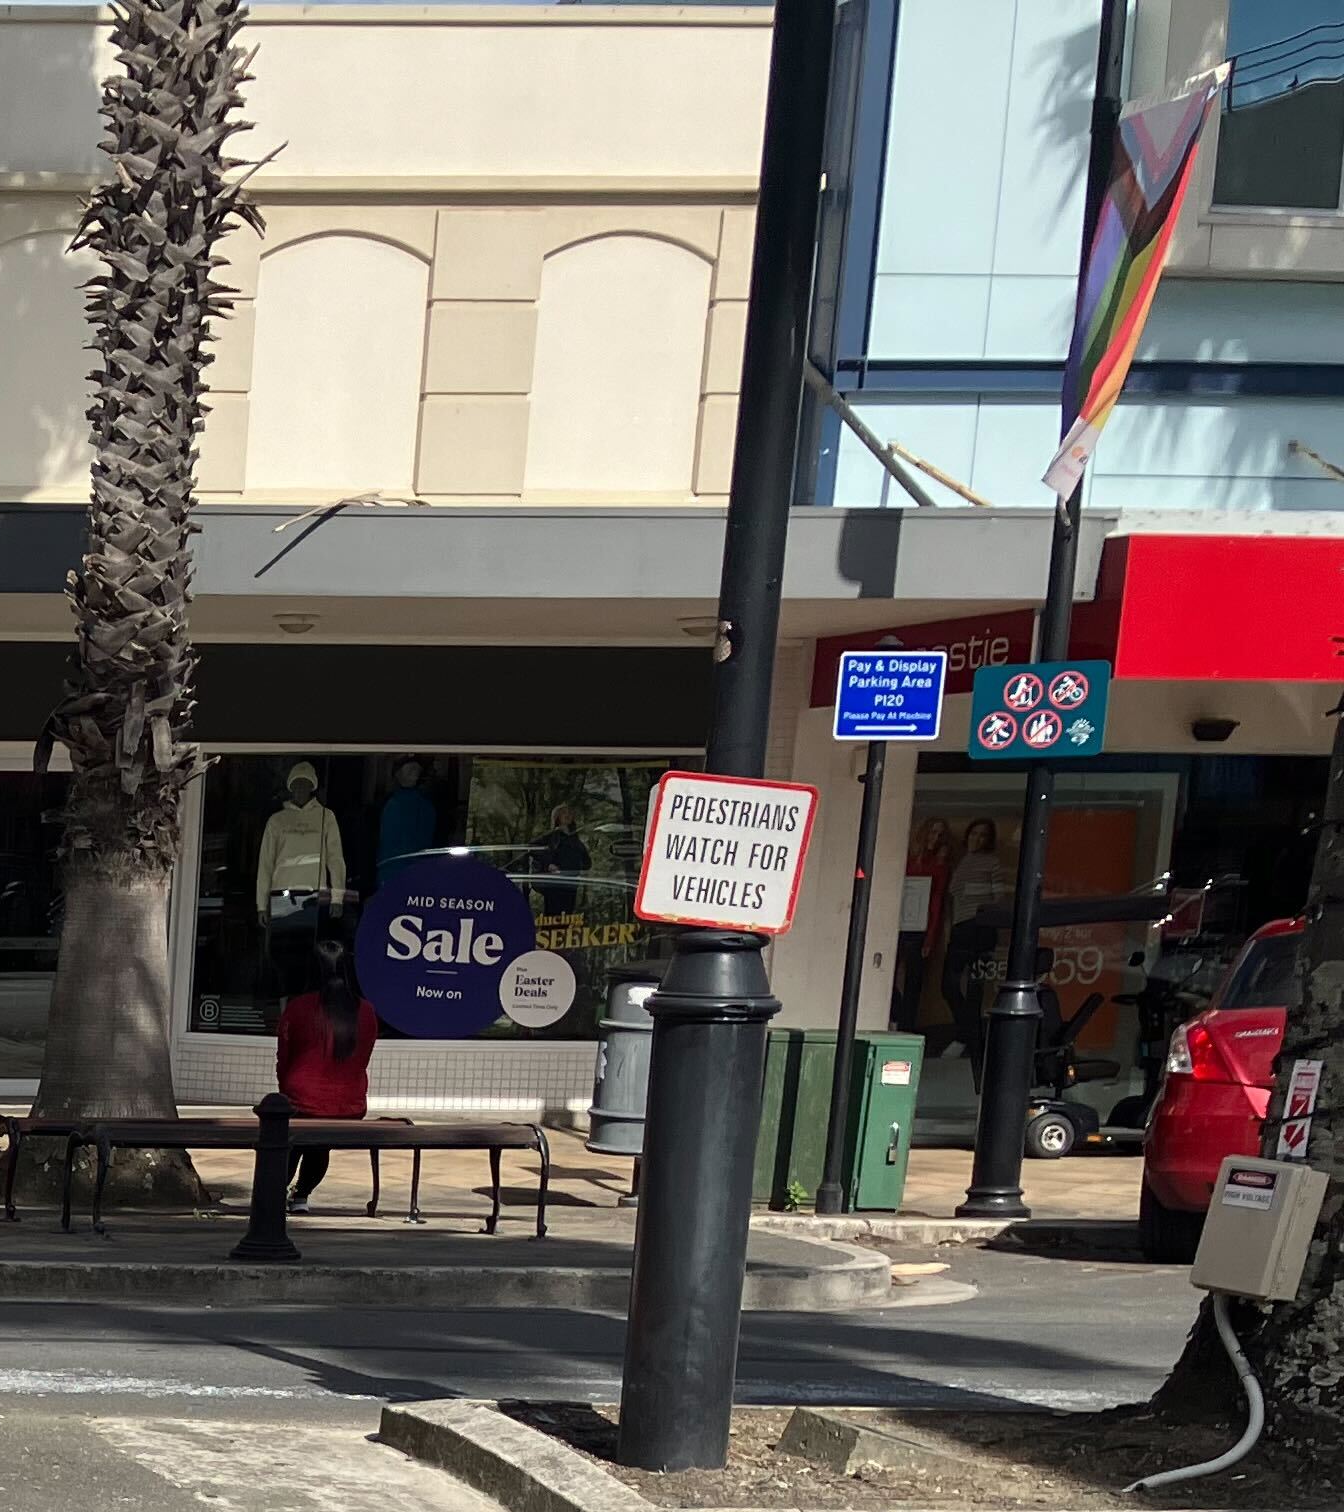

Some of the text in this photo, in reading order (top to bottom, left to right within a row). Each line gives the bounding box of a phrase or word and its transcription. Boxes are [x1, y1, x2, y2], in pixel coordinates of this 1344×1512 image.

[930, 628, 1010, 672] stie
[848, 659, 937, 675] Pay & Display
[849, 675, 932, 690] Parking Area
[843, 711, 869, 720] Please
[871, 711, 886, 721] Pay
[670, 794, 800, 832] PEDESTRIANS
[665, 833, 789, 872] WATCH FOR
[673, 874, 766, 910] VEHICLES
[407, 895, 495, 912] MID SEASON
[535, 911, 585, 928] ducing
[386, 914, 505, 966] Sale
[515, 974, 555, 986] Easter
[416, 985, 463, 1001] Now on
[514, 986, 548, 998] Deals
